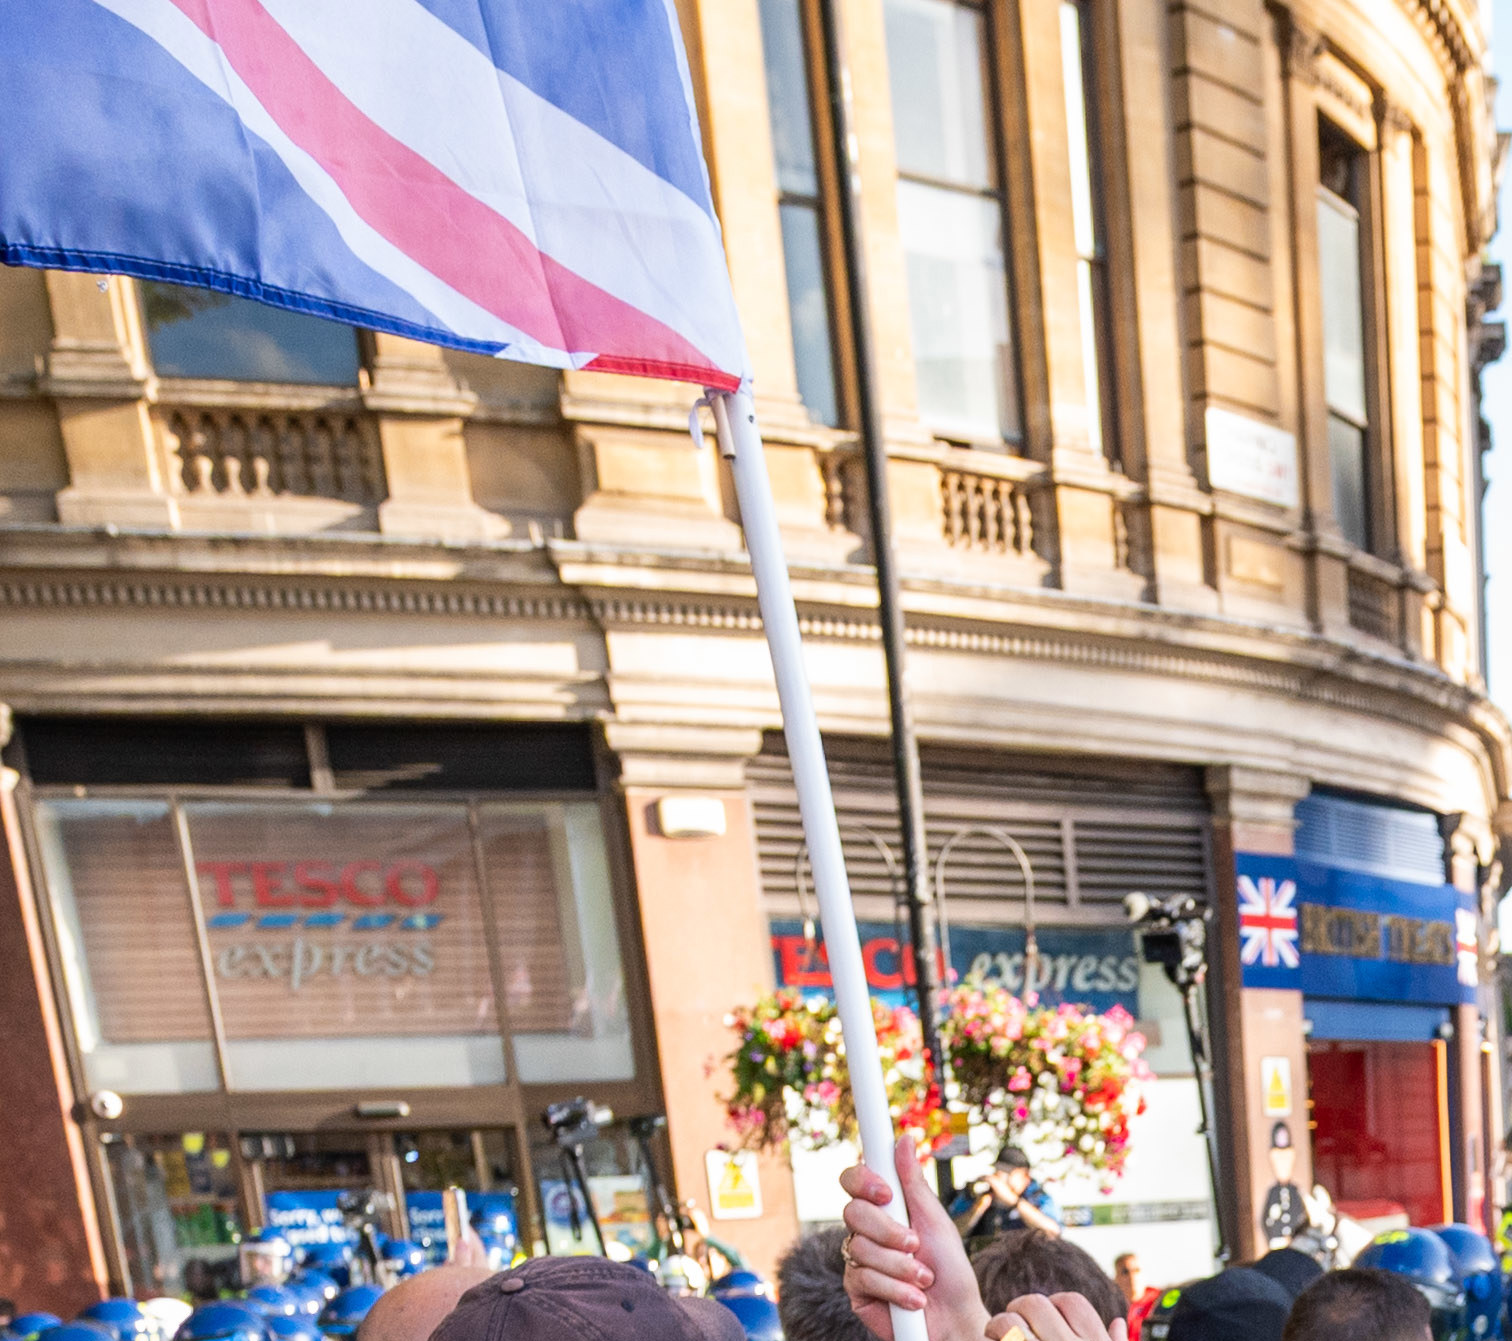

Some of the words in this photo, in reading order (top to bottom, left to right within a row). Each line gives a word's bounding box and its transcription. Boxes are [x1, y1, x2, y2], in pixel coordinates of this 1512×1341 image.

[194, 860, 439, 907] TESCO
[217, 936, 435, 990] express
[969, 952, 1139, 997] express
